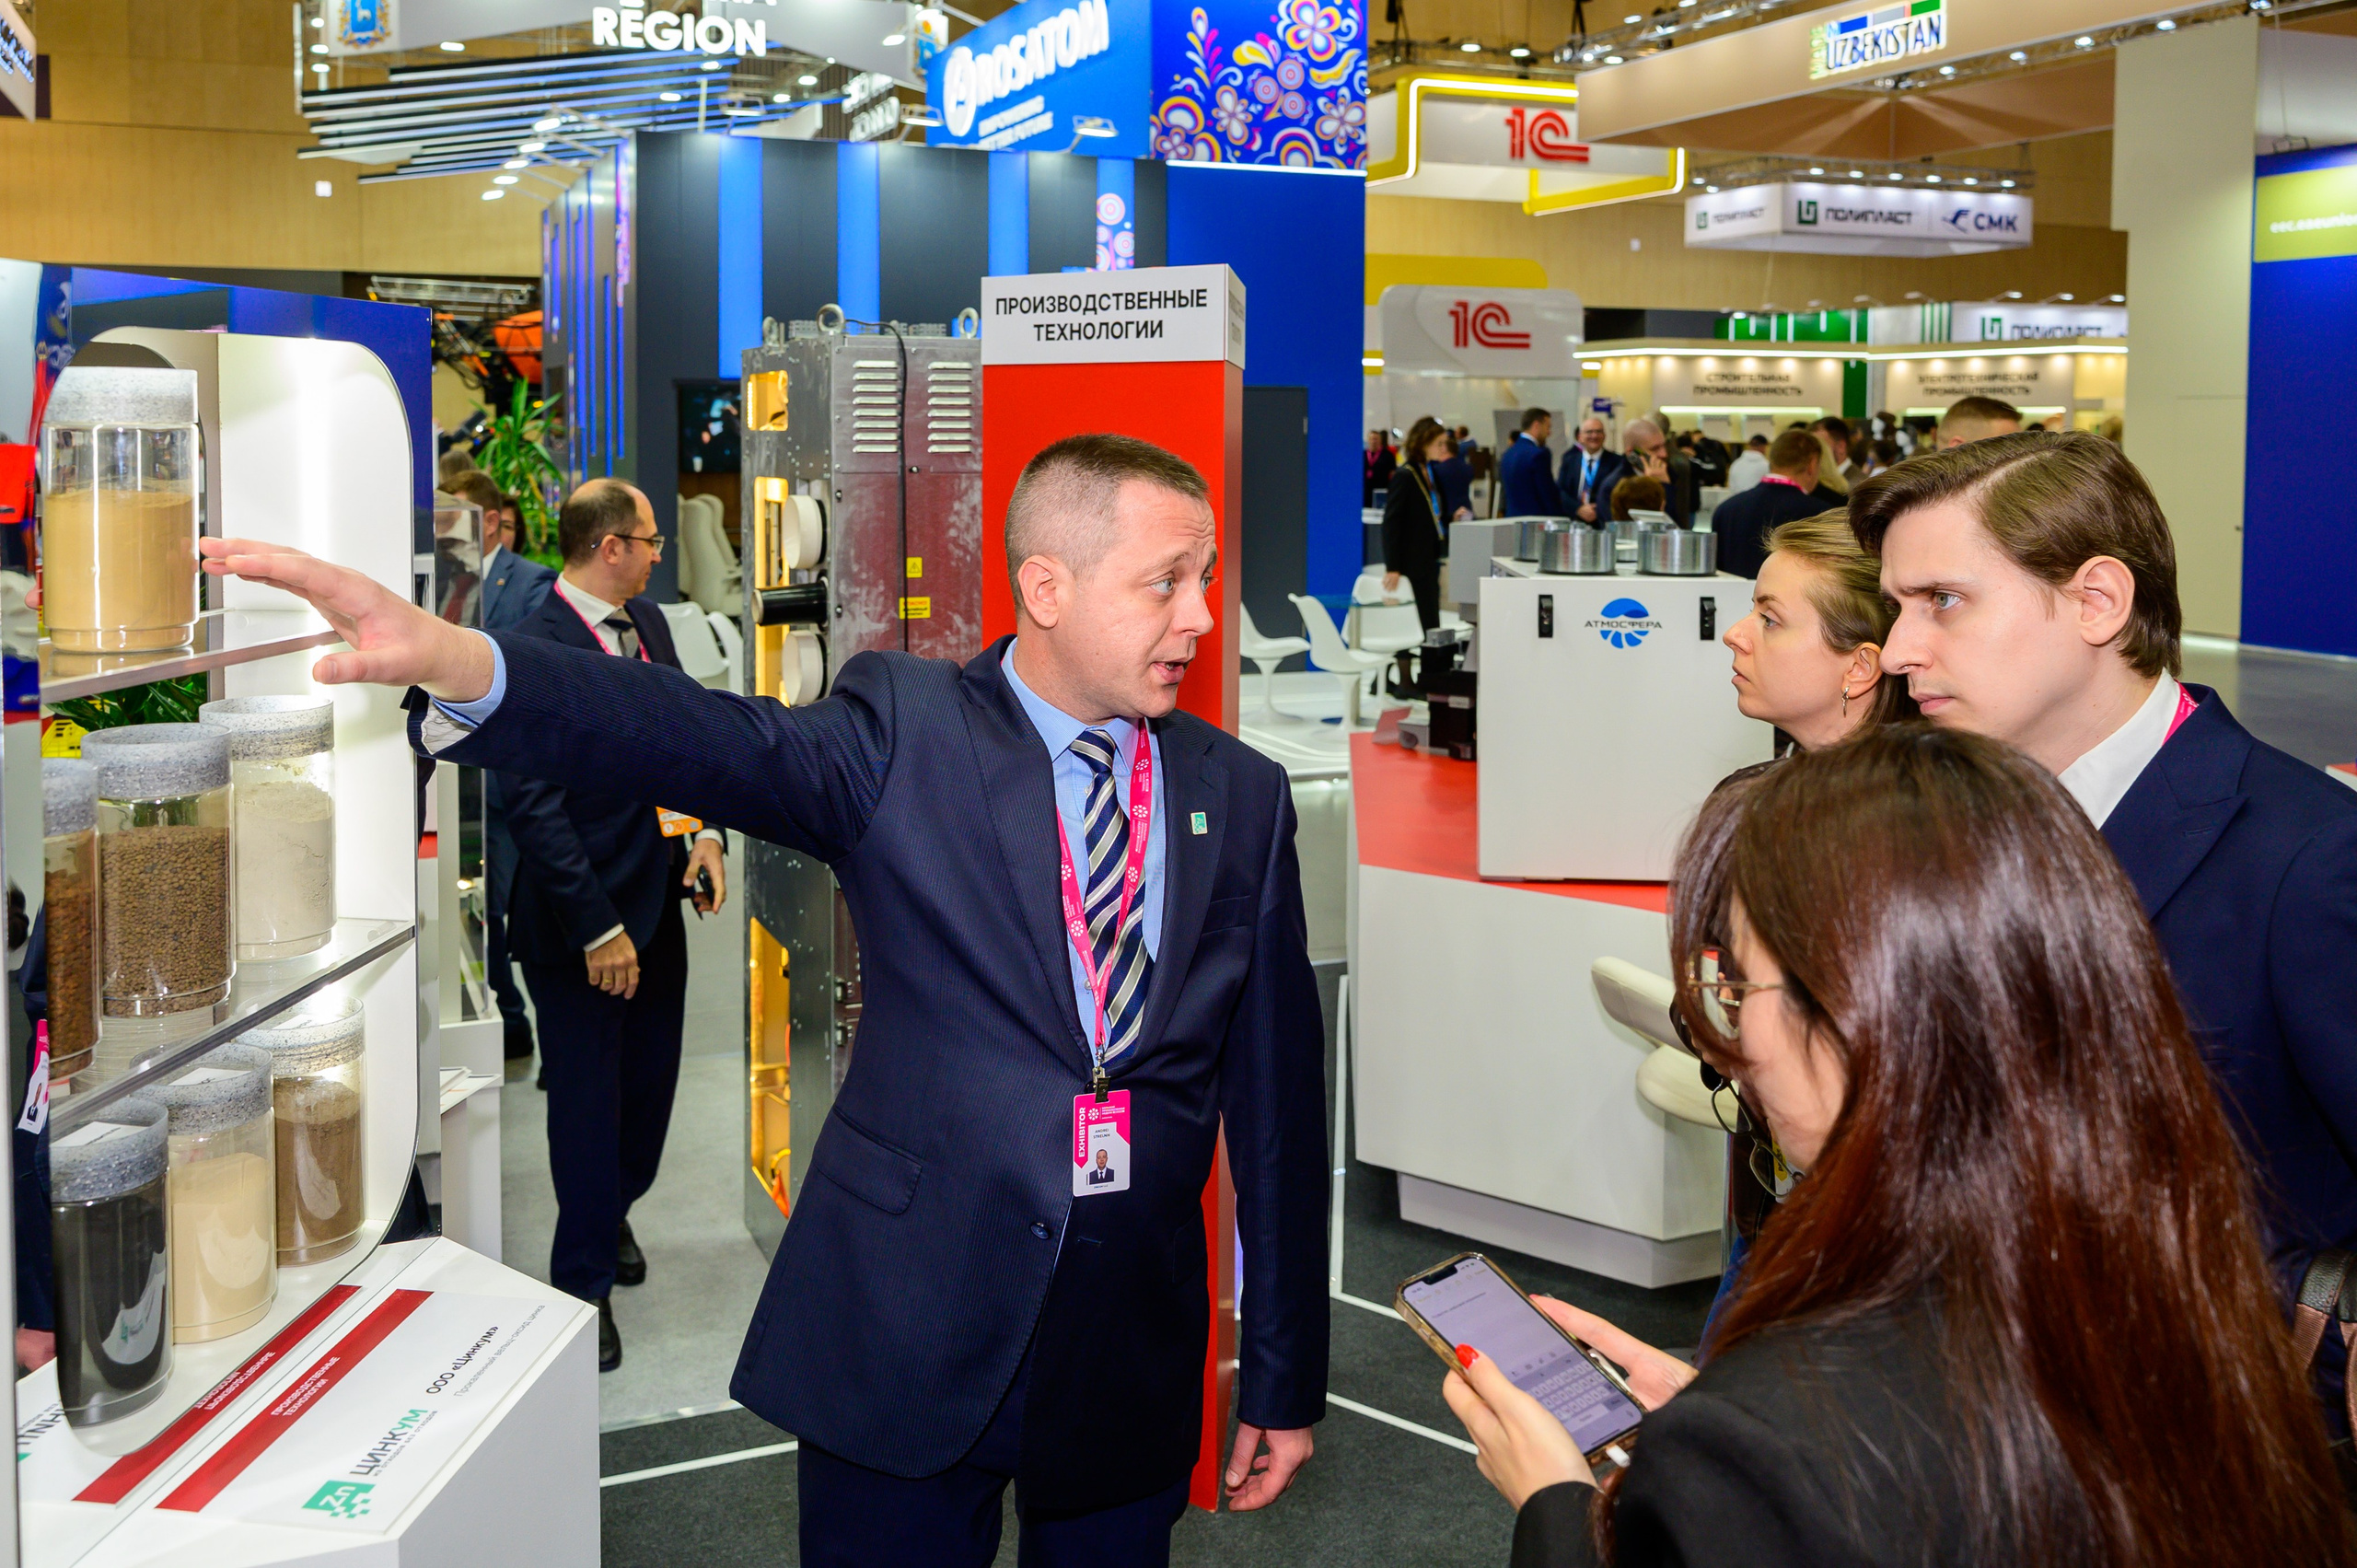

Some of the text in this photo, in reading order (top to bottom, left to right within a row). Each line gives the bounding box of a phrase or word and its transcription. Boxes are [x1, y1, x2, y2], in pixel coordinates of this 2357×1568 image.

[975, 0, 1109, 107] ROSATOM
[1827, 13, 1947, 74] UZBEKISTAN
[1825, 207, 1913, 225] ПОЛИПЛАСТ
[1973, 213, 2018, 231] СМК
[2270, 212, 2357, 233] eec.eaeunio
[995, 288, 1208, 315] ПРОИЗВОДСТВЕННЫЕ
[1033, 319, 1164, 342] ТЕХНОЛОГИИ
[1693, 385, 1804, 396] ПРОМЫШЛЕННОСТЬ
[1922, 385, 2032, 396] ПРОМЫШЛЕННОСТЬ
[1584, 620, 1663, 629] АТМОСФЕРА
[1078, 1107, 1086, 1158] EXHIBITOR
[426, 1326, 499, 1394] ООО «Цинкум»
[453, 1305, 546, 1397] Прокаленный вельц-оксид цинка
[270, 1356, 341, 1416] ПРОИЗВОДСТВЕННЫЕ
[282, 1378, 330, 1417] ТЕХНОЛОГИИ
[349, 1409, 429, 1476] ЦИНКУМ
